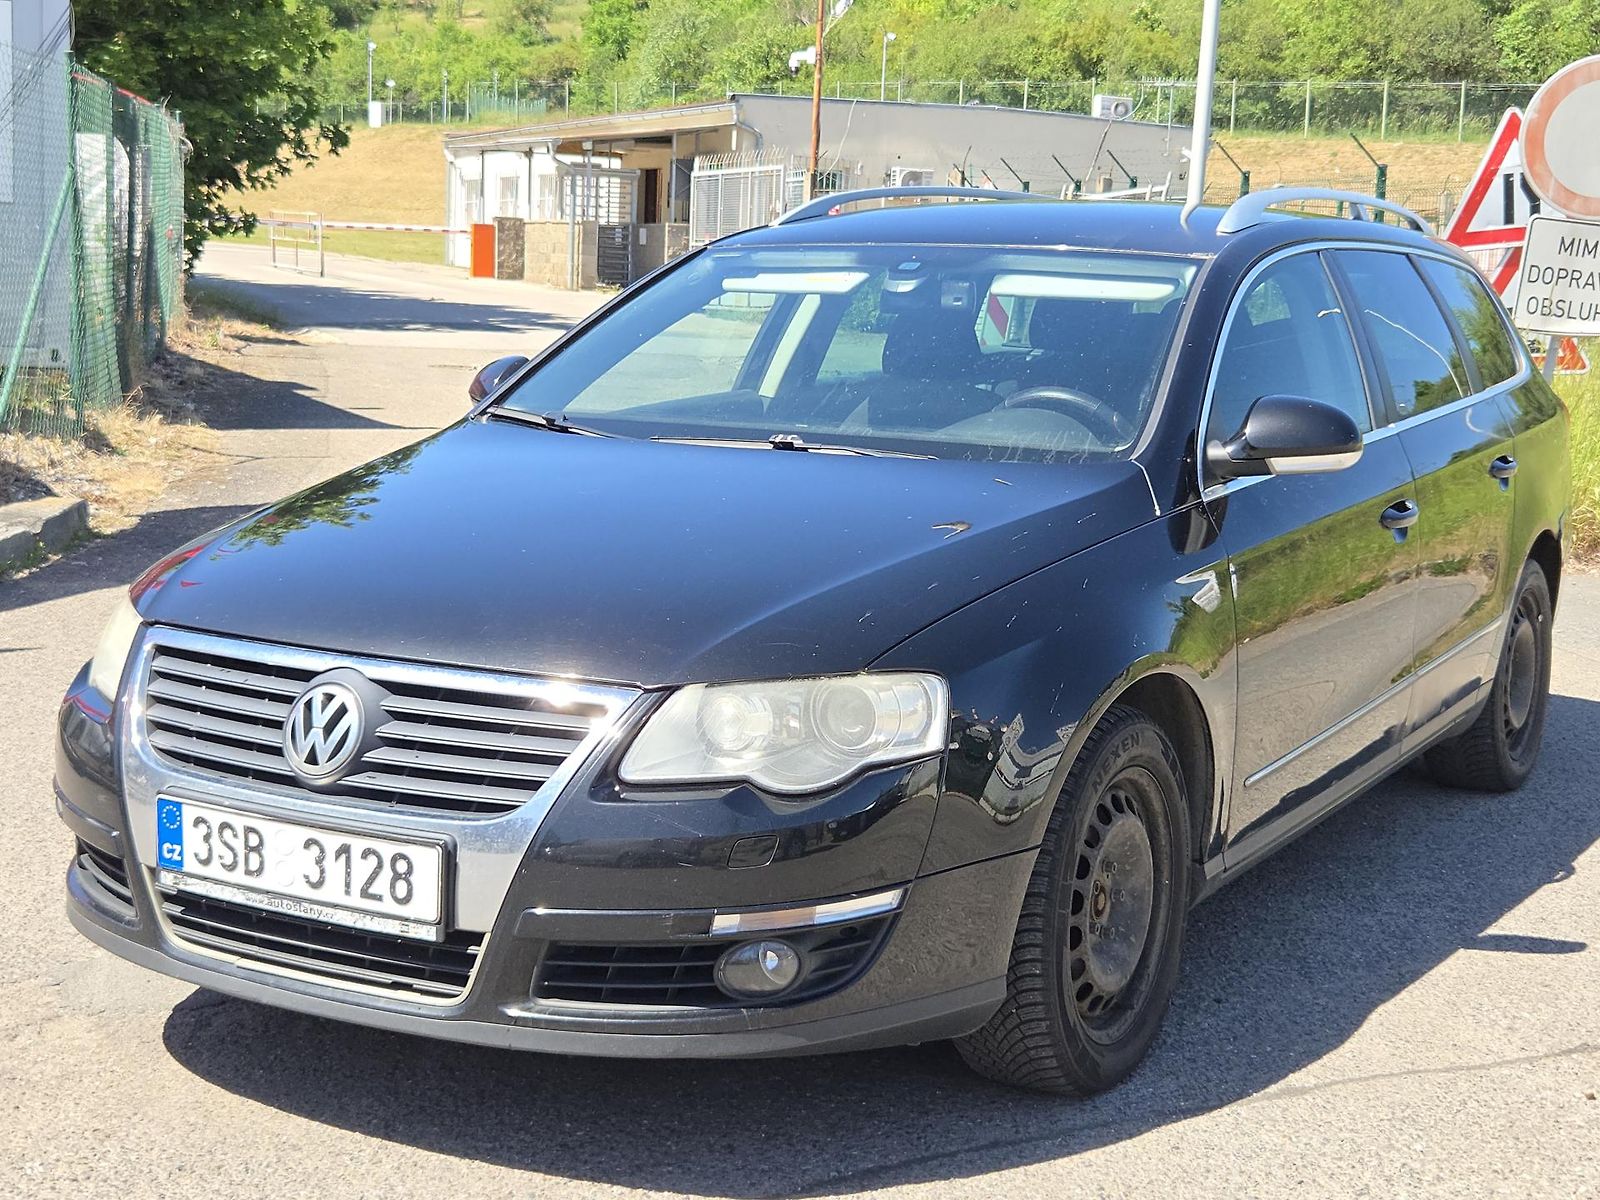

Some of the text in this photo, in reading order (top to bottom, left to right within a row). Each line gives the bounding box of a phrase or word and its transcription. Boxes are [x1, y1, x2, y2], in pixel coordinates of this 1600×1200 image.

[1527, 265, 1600, 291] DOPRA
[289, 690, 353, 768] VW
[1092, 732, 1141, 793] NEXEN
[161, 841, 182, 862] CZ
[192, 815, 415, 906] 3SB 3128
